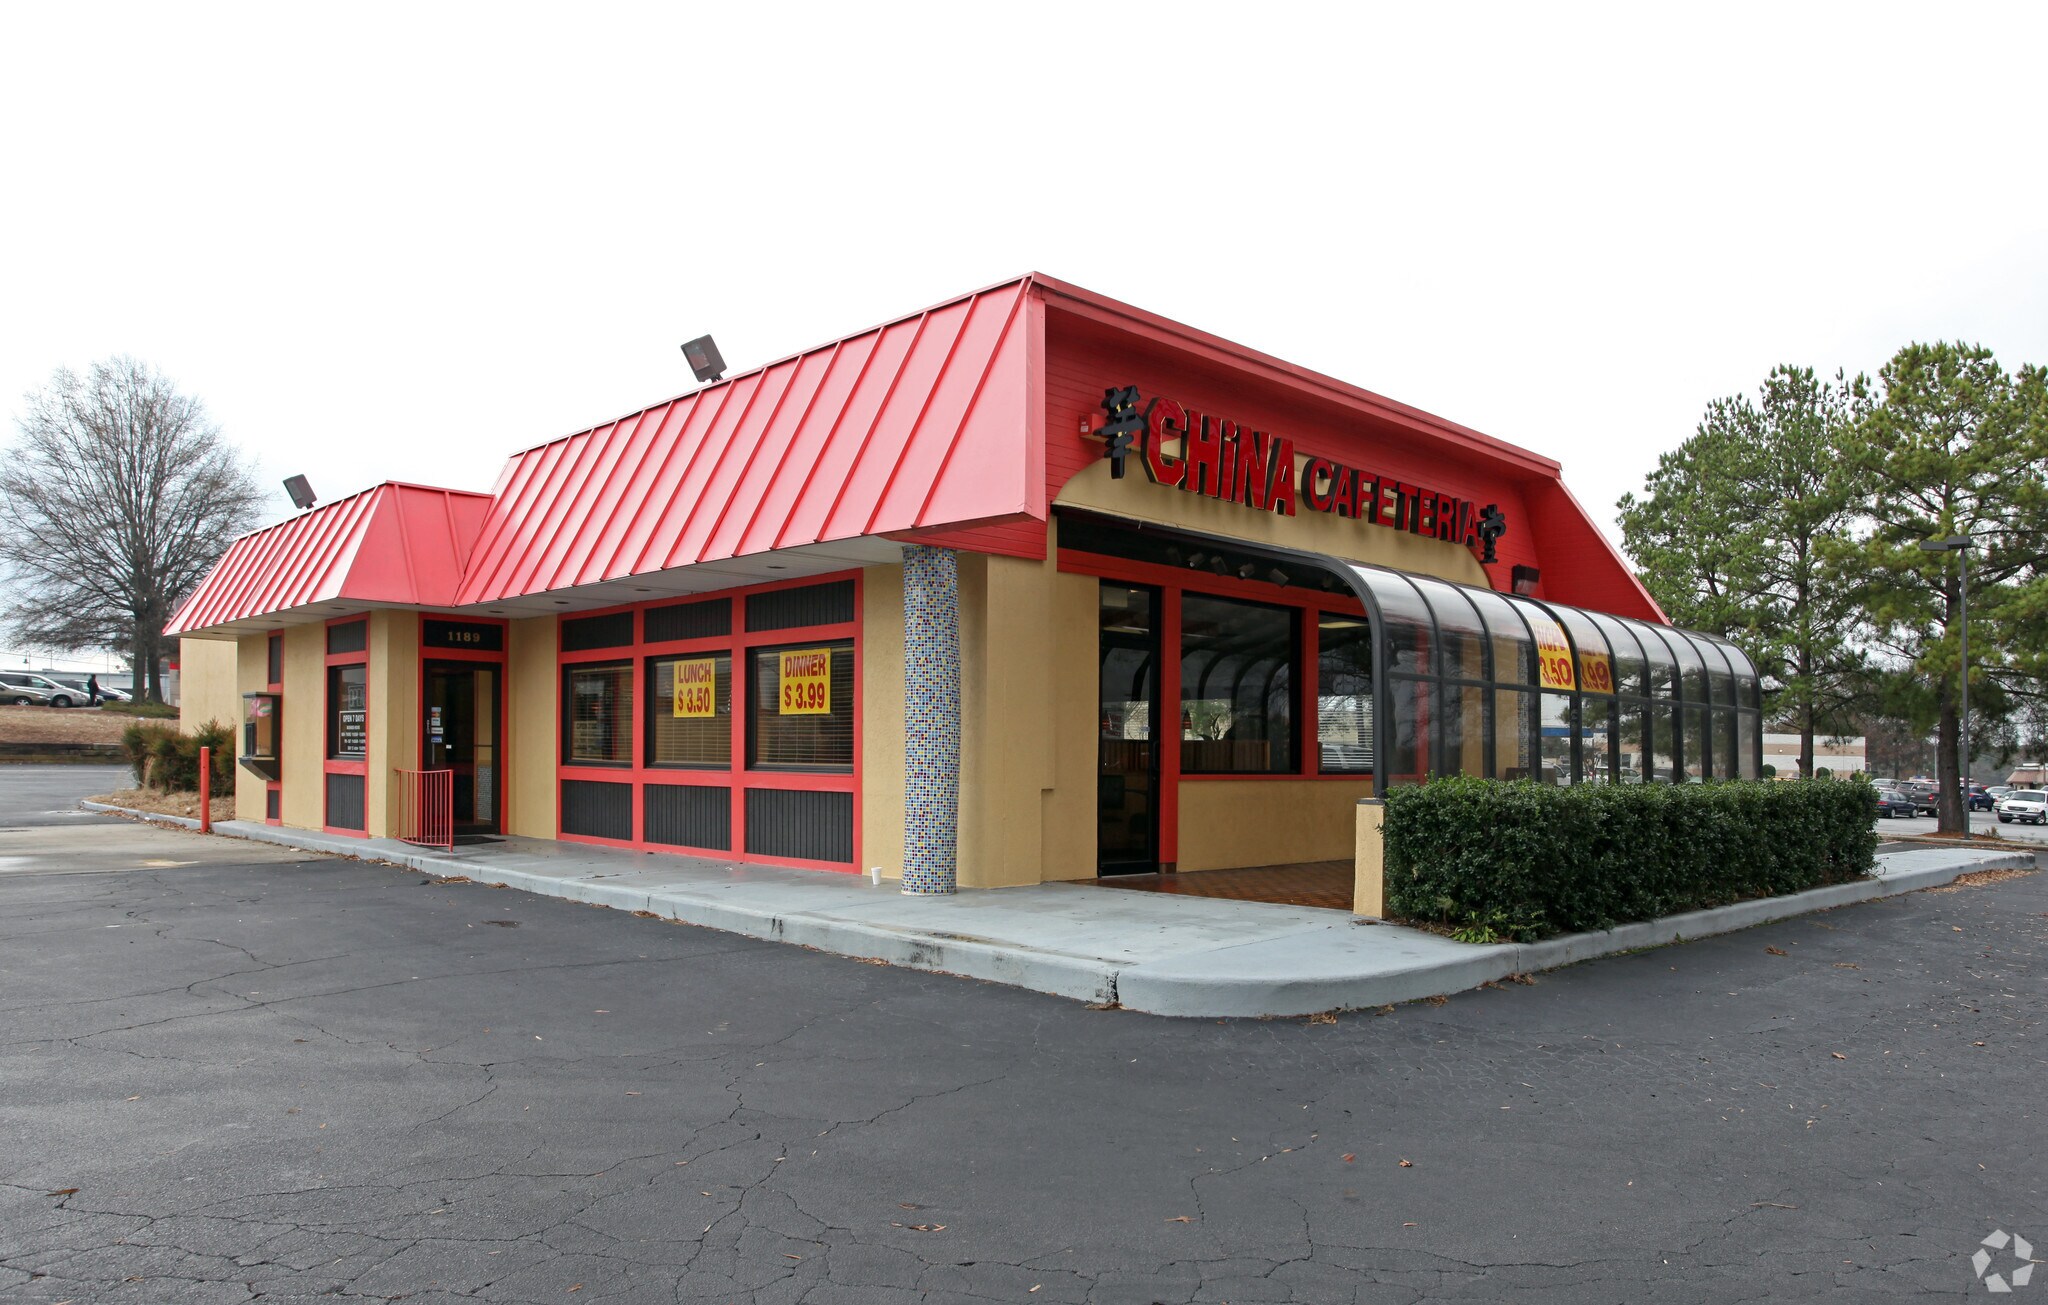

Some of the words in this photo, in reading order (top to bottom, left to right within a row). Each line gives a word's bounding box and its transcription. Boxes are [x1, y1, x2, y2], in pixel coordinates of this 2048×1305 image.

[1301, 457, 1478, 547] CAFETERIA
[448, 631, 480, 642] 1189
[678, 663, 711, 684] LUNCH
[785, 654, 826, 678] DINNER
[687, 687, 711, 713] 3.50
[796, 682, 825, 709] 3.99
[343, 714, 352, 723] OPEN
